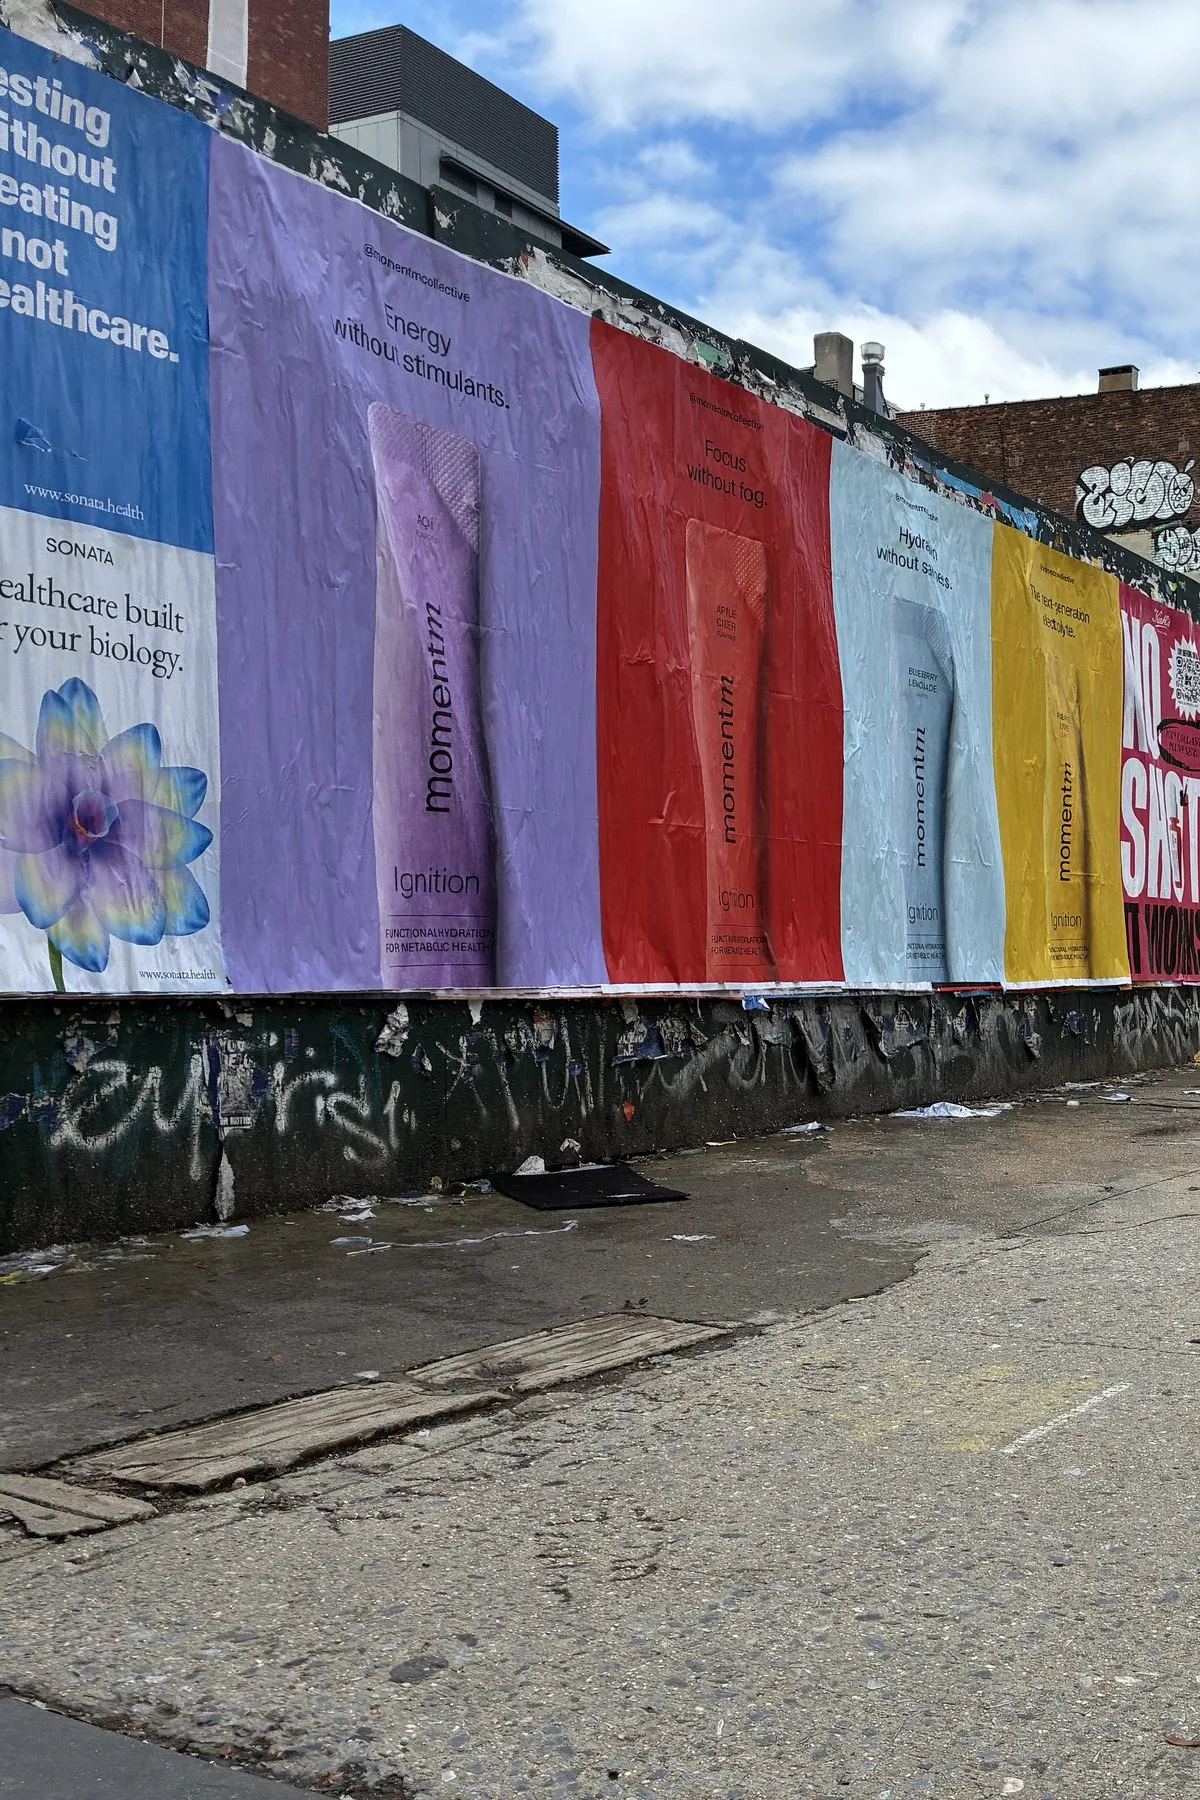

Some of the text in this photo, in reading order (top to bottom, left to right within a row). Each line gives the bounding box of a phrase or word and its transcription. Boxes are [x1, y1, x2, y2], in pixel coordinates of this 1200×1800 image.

[1, 226, 69, 277] not
[384, 302, 451, 357] Energy
[329, 315, 511, 409] without stimulants.
[704, 439, 746, 472] Focus
[24, 483, 145, 521] www.sonata.health
[686, 463, 769, 508] without fog.
[46, 537, 114, 566] SONATA
[876, 546, 919, 572] without
[124, 593, 184, 633] built
[716, 617, 737, 631] CIDER
[14, 623, 82, 654] your
[88, 625, 183, 679] biology.
[1121, 609, 1161, 760] NO
[424, 601, 453, 813] momentm
[718, 675, 736, 844] momentm
[913, 727, 926, 867] momentm
[1060, 762, 1072, 882] momentm
[393, 866, 481, 899] Ignition
[385, 942, 400, 953] FOR
[451, 941, 490, 952] HEALTH
[437, 928, 495, 941] HYDRATION
[138, 967, 216, 981] www.sonata.health
